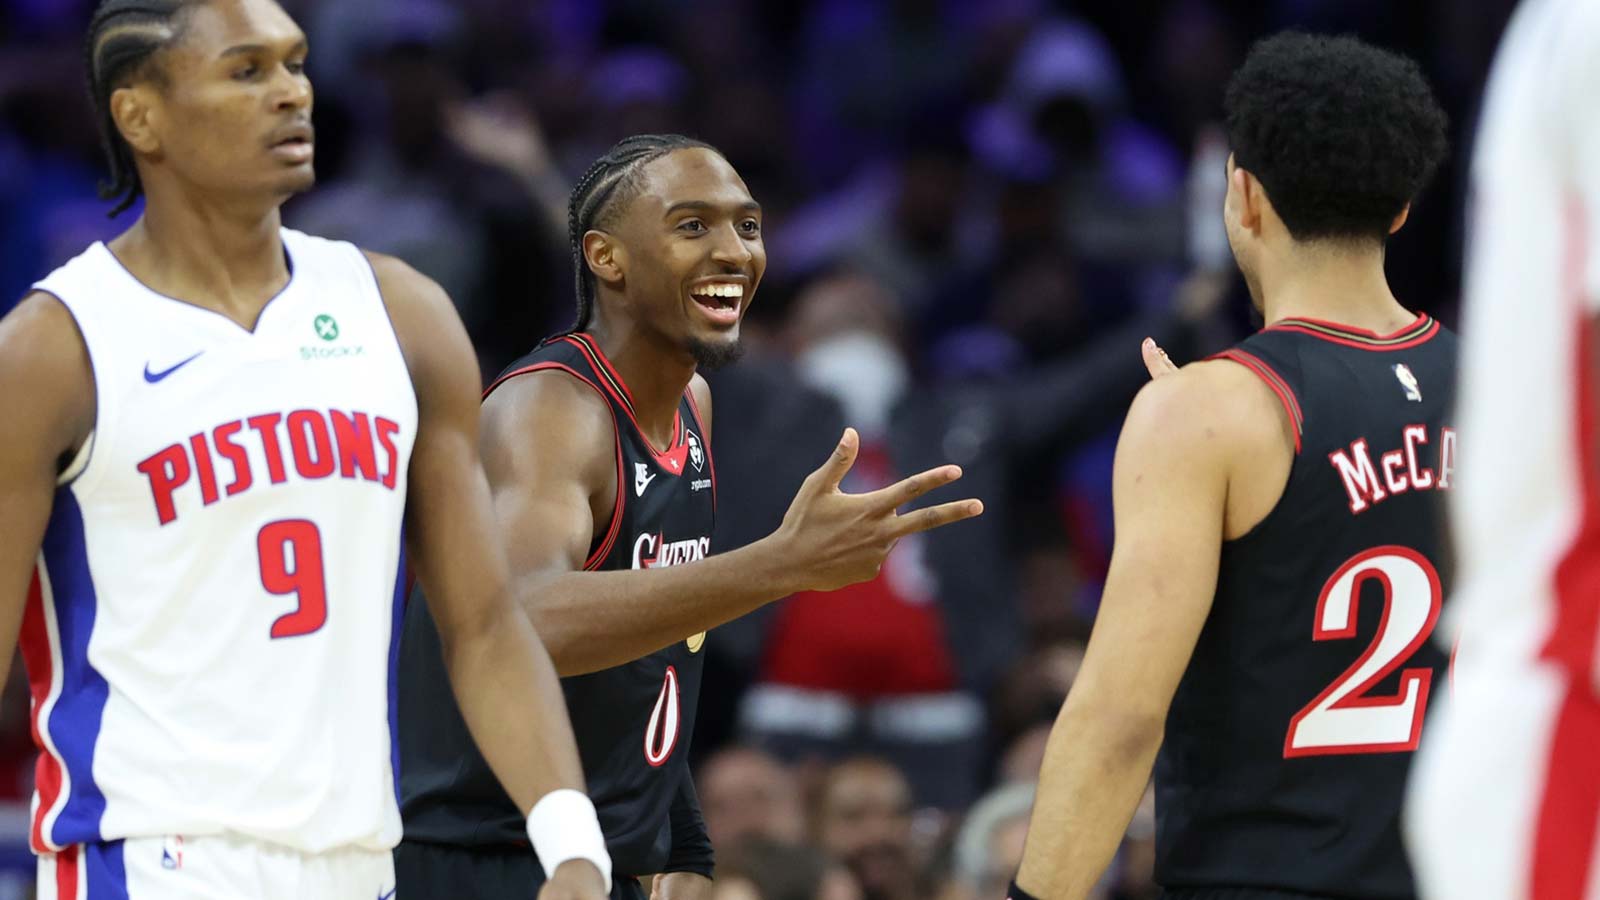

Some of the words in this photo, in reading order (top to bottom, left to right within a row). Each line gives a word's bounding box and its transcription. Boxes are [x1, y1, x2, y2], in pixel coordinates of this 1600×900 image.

[136, 408, 400, 526] PISTONS
[256, 518, 328, 639] 9
[1282, 544, 1459, 758] 2
[643, 665, 681, 767] 0
